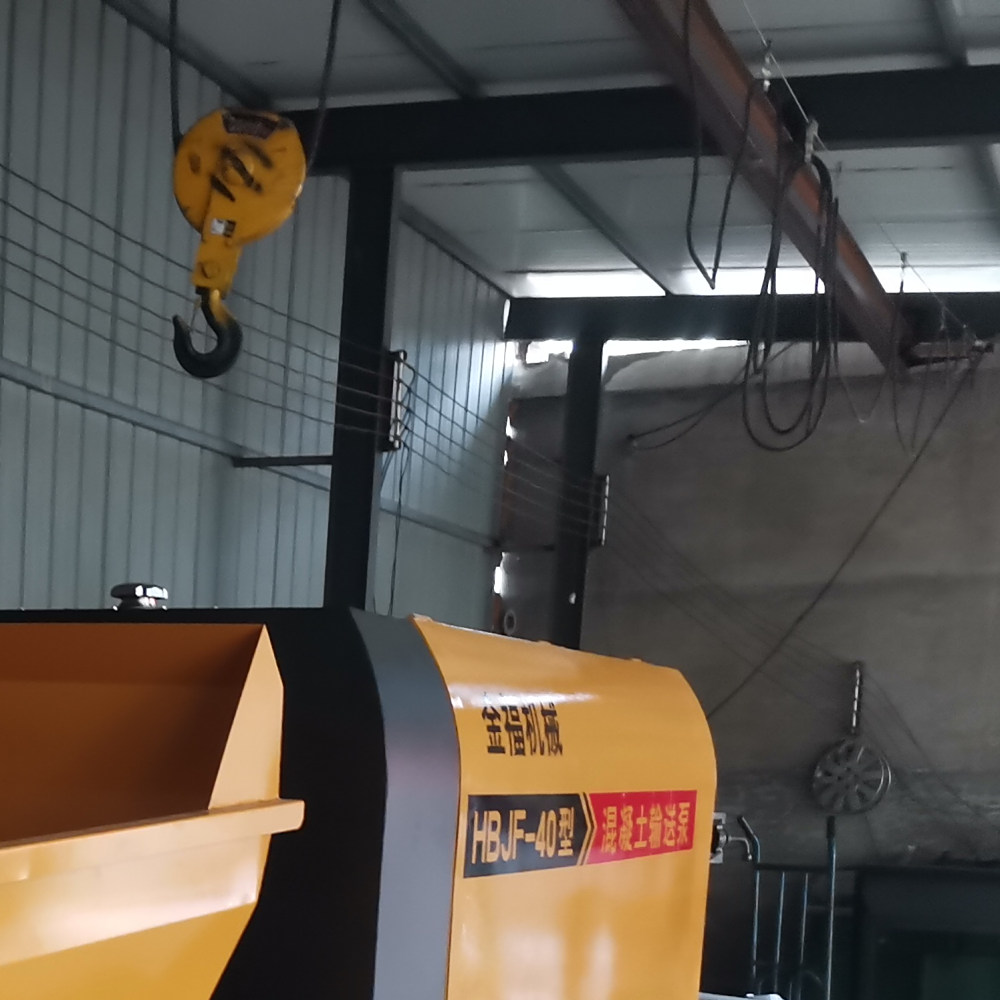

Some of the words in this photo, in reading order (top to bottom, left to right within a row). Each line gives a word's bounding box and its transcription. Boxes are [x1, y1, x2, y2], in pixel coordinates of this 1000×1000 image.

[471, 806, 575, 864] HBJF-40型
[601, 802, 690, 853] 混凝土输送泵
